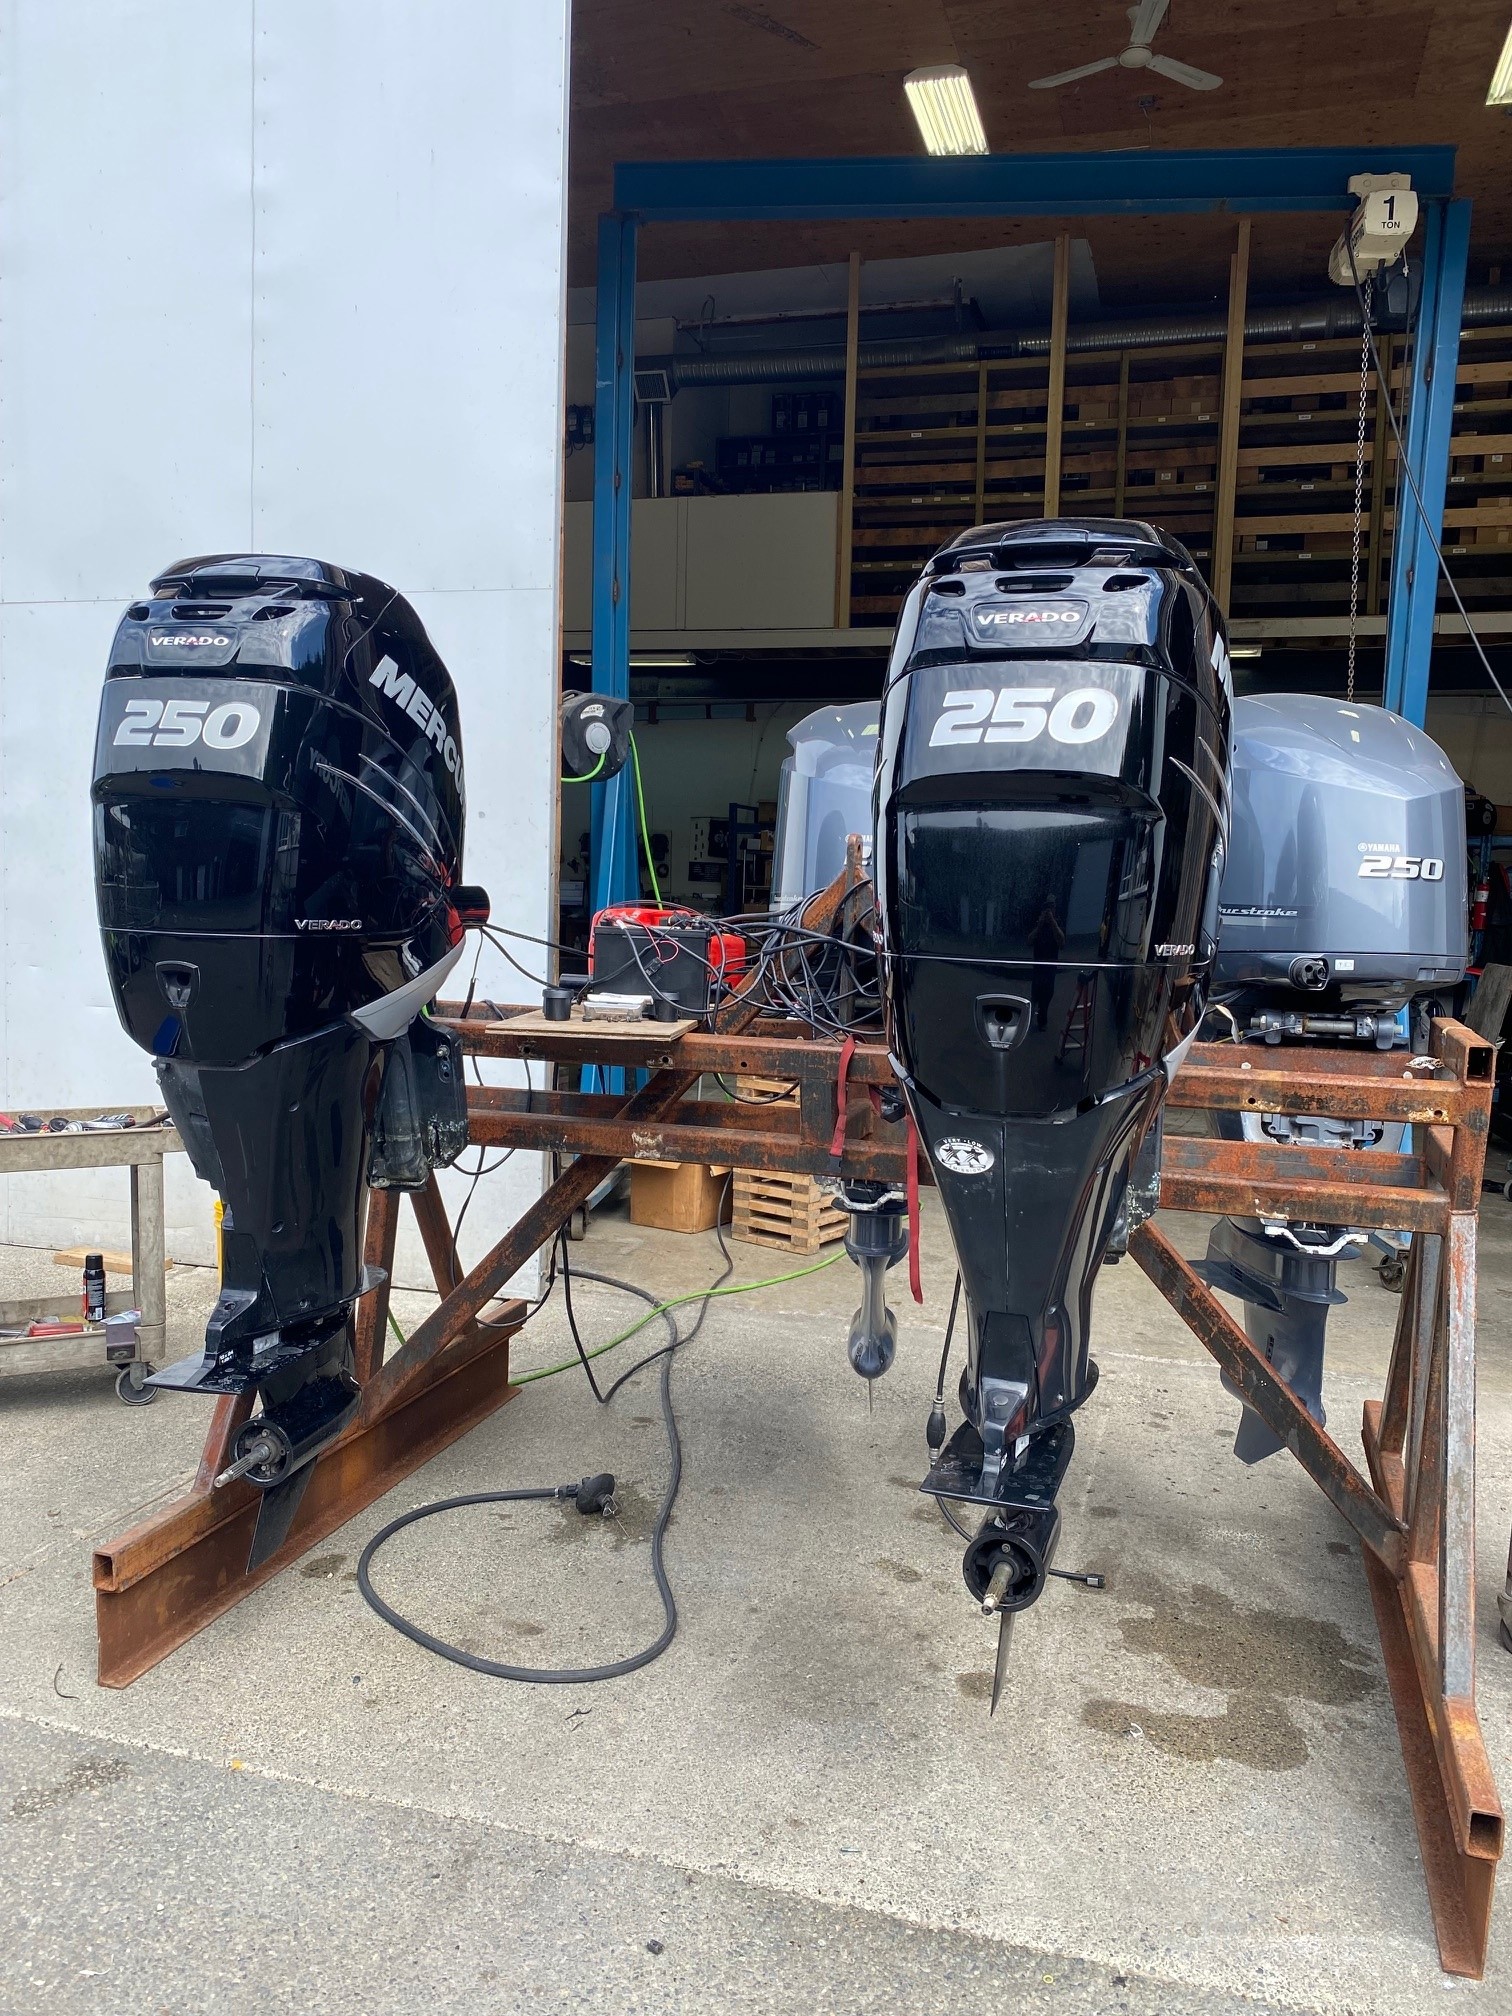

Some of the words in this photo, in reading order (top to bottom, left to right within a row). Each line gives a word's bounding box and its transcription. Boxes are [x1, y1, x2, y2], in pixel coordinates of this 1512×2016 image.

[1383, 195, 1395, 221] 1
[1381, 221, 1400, 229] TON
[977, 611, 1080, 626] VERADO
[151, 635, 229, 647] VERADO
[928, 687, 1119, 747] 250
[113, 699, 260, 750] 250
[368, 654, 466, 808] MERCU
[1368, 843, 1400, 853] YAMAHA
[1357, 855, 1444, 881] 250
[1218, 906, 1298, 918] urstroke
[294, 918, 362, 931] VERADO
[1154, 943, 1196, 957] VERADO
[967, 1139, 983, 1148] LOW
